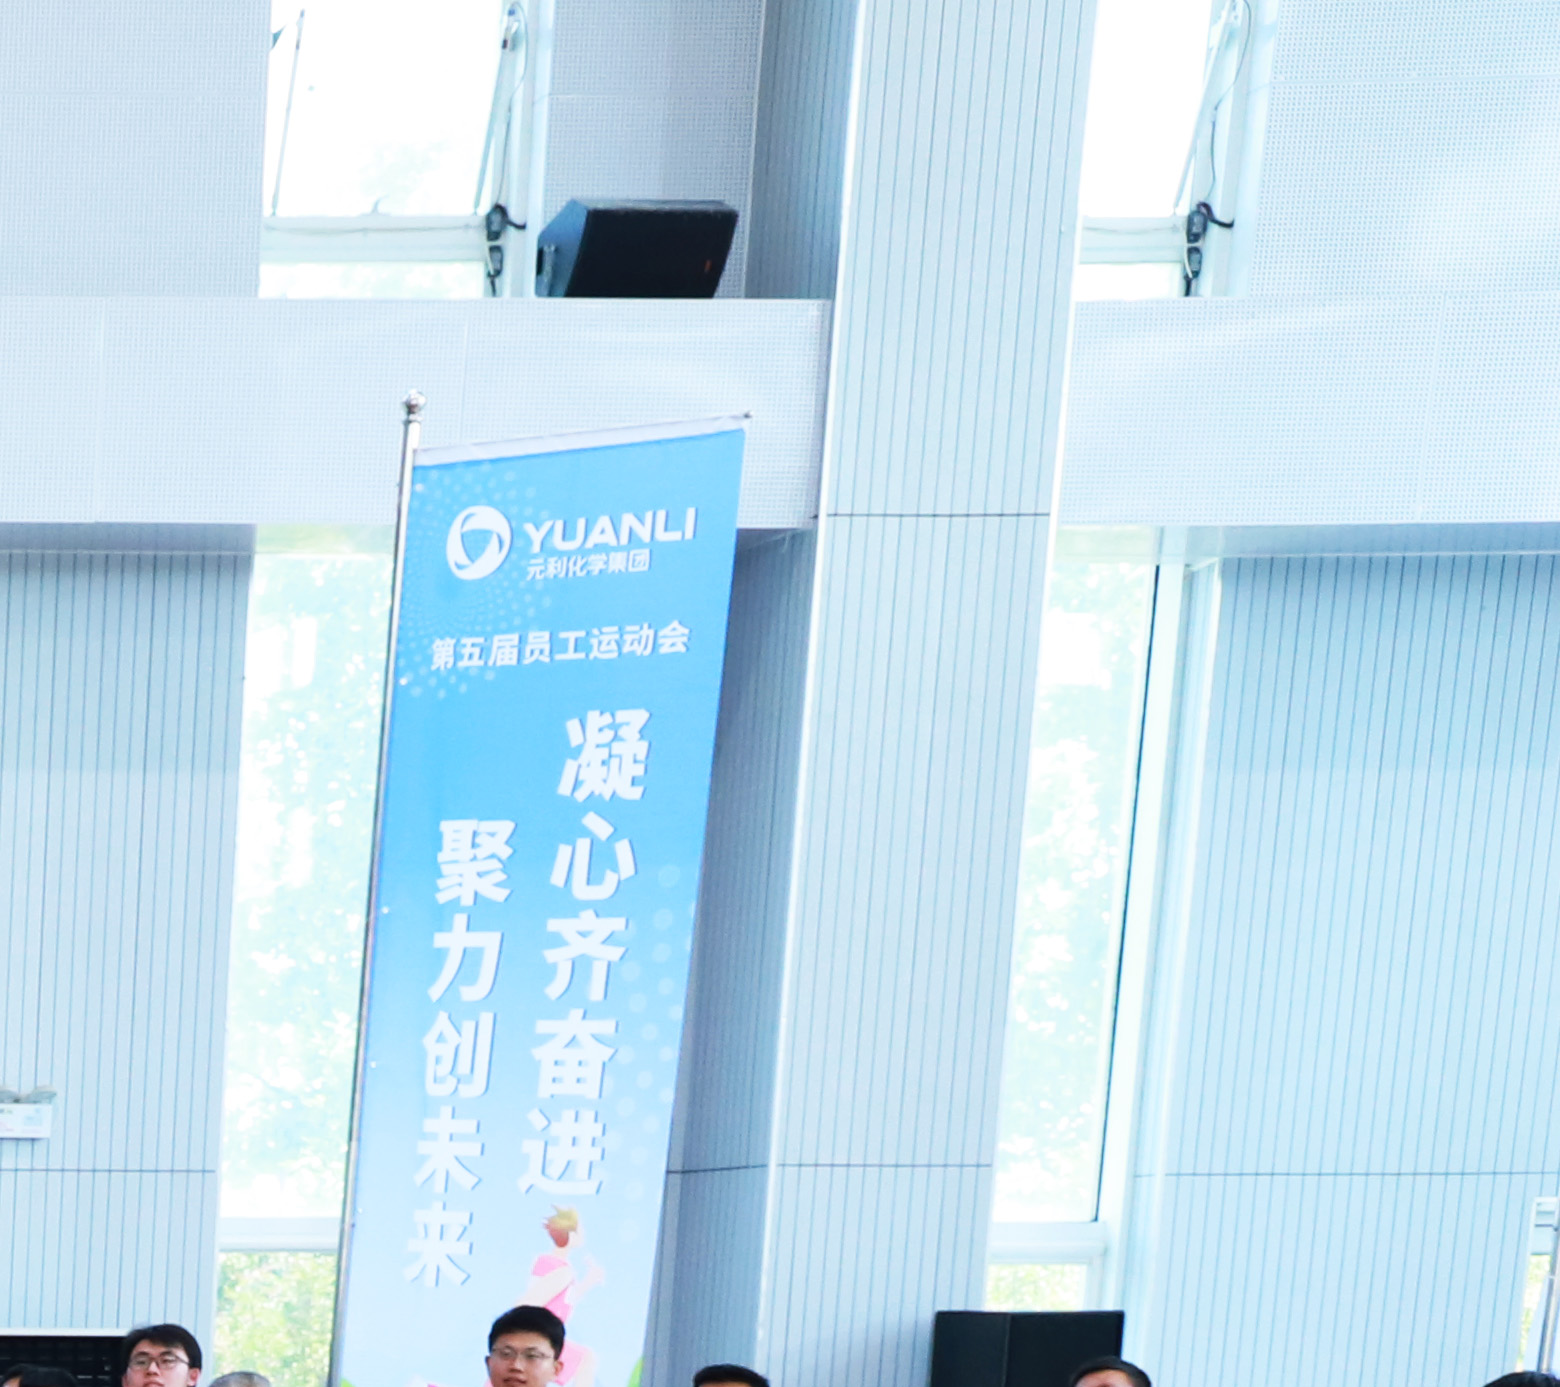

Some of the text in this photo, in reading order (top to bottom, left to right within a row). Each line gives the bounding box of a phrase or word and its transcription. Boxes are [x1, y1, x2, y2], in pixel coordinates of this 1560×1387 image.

[524, 506, 697, 554] YUANLI
[526, 548, 652, 582] 元利化学集团
[430, 619, 691, 671] 第五届员工运动会
[518, 708, 651, 1196] 凝心齐奋进
[404, 818, 517, 1288] 聚力创未来
